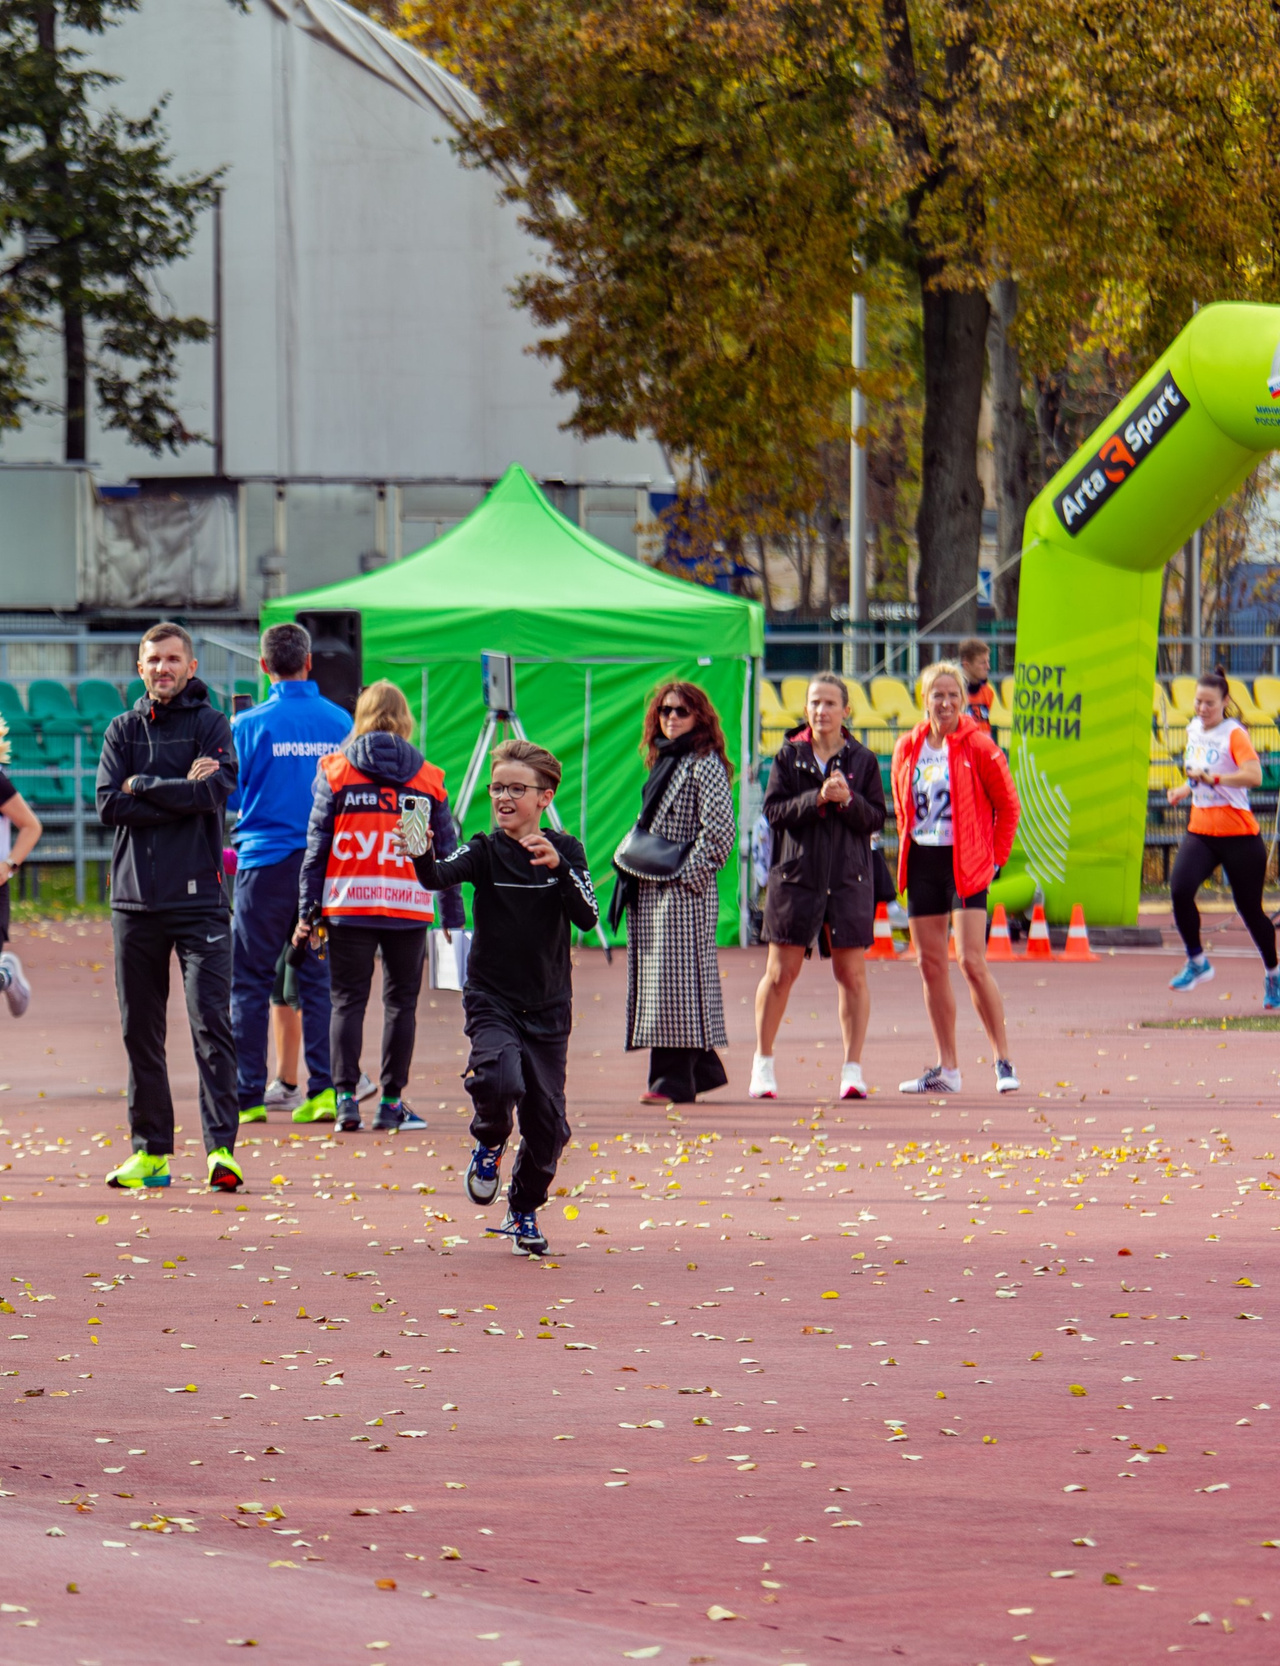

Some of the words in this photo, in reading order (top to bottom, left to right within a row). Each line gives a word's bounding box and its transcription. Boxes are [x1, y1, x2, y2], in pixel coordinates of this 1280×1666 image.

[1061, 469, 1107, 526] Arta
[1124, 383, 1181, 452] Sport
[1016, 663, 1067, 688] ПОРТ
[272, 742, 340, 757] КИРОВЭНЕРГО
[344, 791, 378, 807] Arta
[916, 789, 952, 822] 82
[332, 831, 413, 868] СУД
[347, 885, 413, 904] МОСКОСКИЙ
